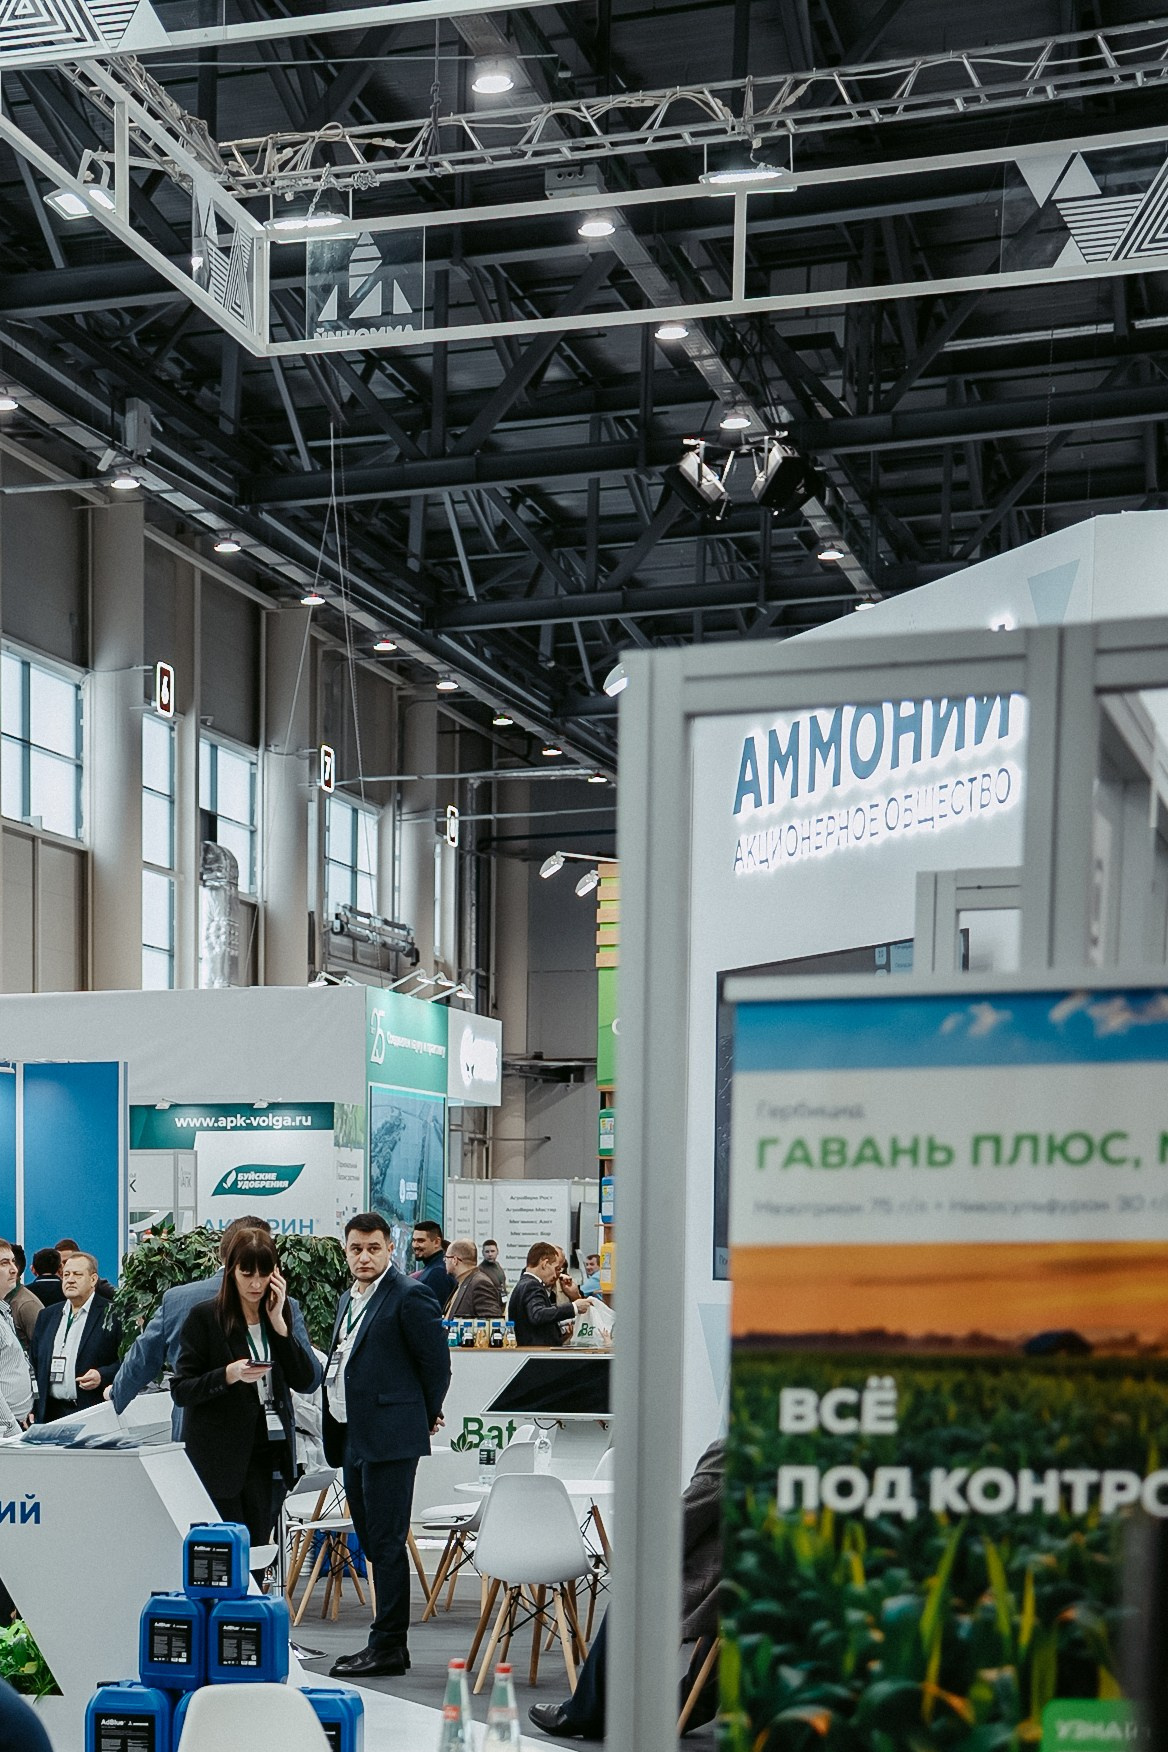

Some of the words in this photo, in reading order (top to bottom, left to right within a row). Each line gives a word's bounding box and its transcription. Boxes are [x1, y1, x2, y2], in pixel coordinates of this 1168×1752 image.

[733, 803, 880, 872] АКЦИОНЕРНОЕ
[884, 767, 1011, 830] ОБЩЕСТВО
[175, 1113, 312, 1129] www.apk-volga.ru
[757, 1134, 956, 1169] ГАВАНЬ
[971, 1131, 1142, 1169] ПЛЮС,
[237, 1171, 277, 1181] БУЙСКИЕ
[237, 1180, 289, 1189] УДОБРЕНИЯ
[780, 1375, 898, 1435] ВСЁ
[777, 1465, 917, 1521] ПОД
